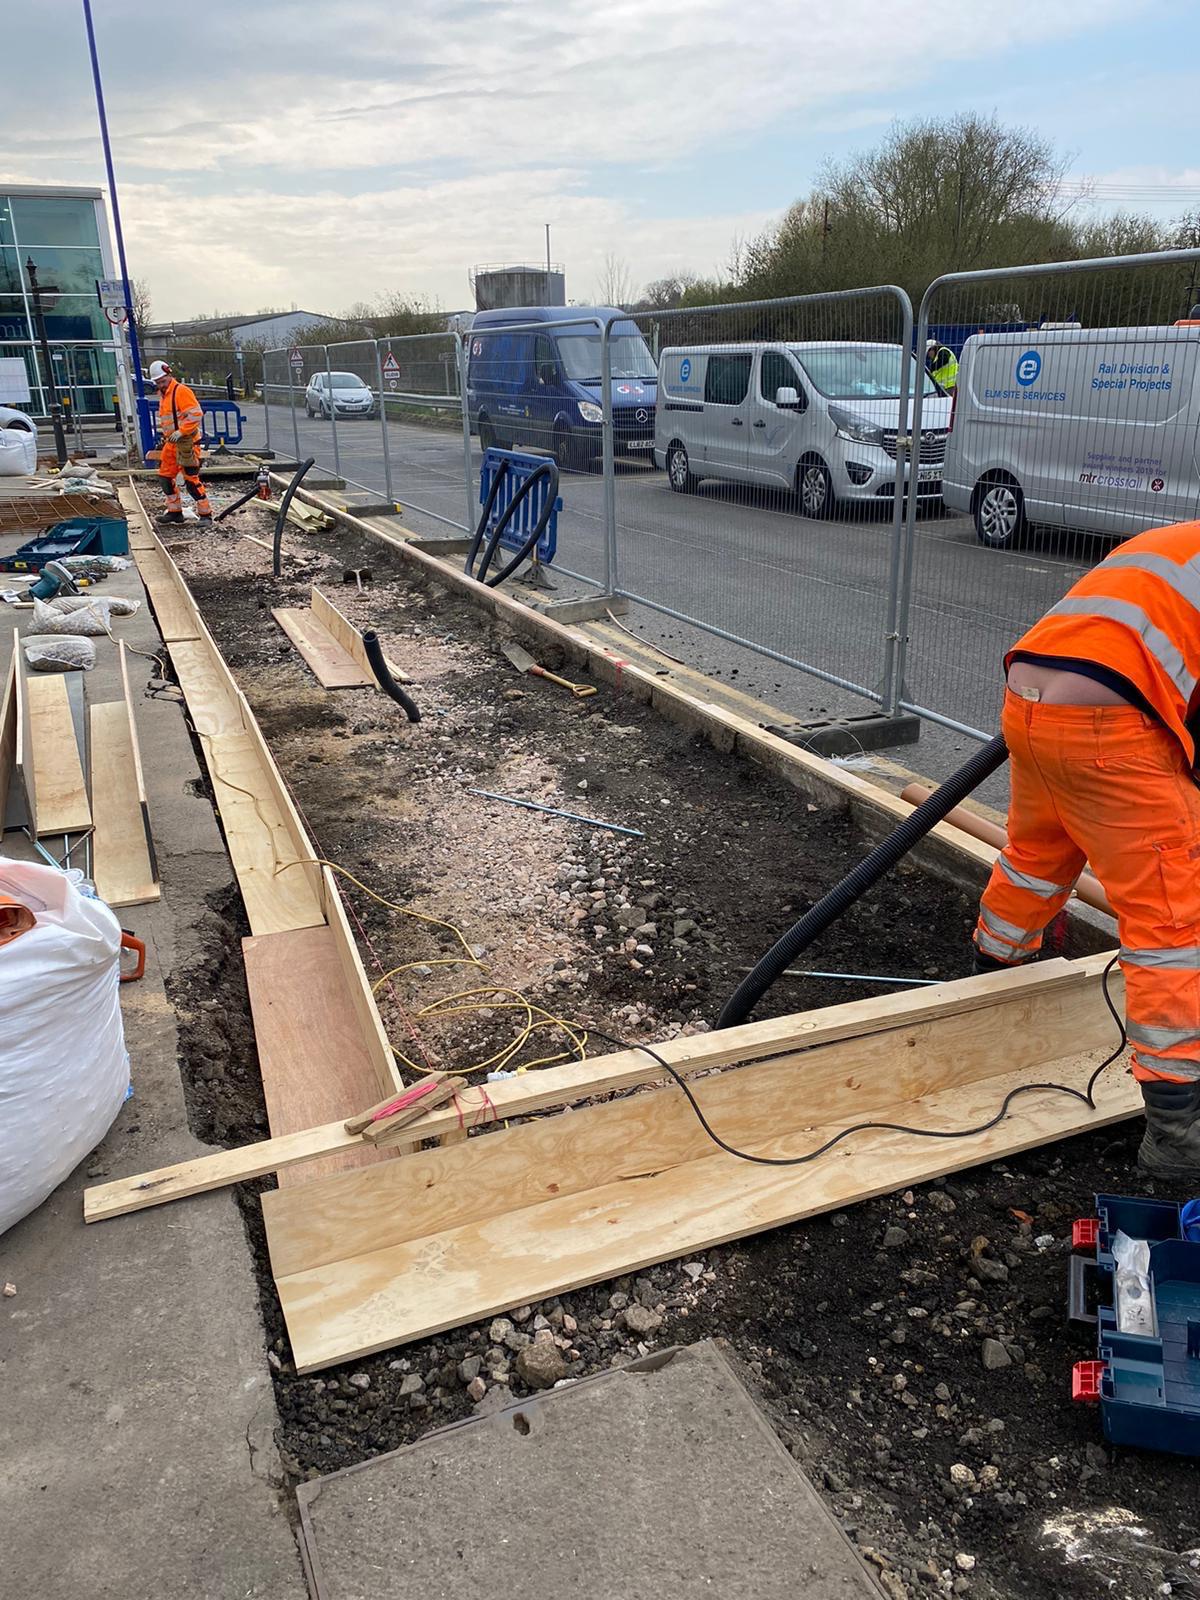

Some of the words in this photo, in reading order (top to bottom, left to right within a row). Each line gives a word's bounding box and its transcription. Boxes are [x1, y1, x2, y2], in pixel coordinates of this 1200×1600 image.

[1098, 363, 1117, 374] Rail
[1119, 363, 1160, 374] Division
[1161, 363, 1170, 374] &
[1091, 378, 1127, 391] Special
[1129, 378, 1172, 392] Projects
[985, 389, 1000, 398] ELM
[1001, 390, 1021, 400] SITE
[1022, 391, 1066, 401] SERVICES
[1118, 455, 1132, 463] and
[1134, 456, 1162, 466] partner
[1135, 466, 1153, 475] 2019
[1155, 468, 1167, 476] for
